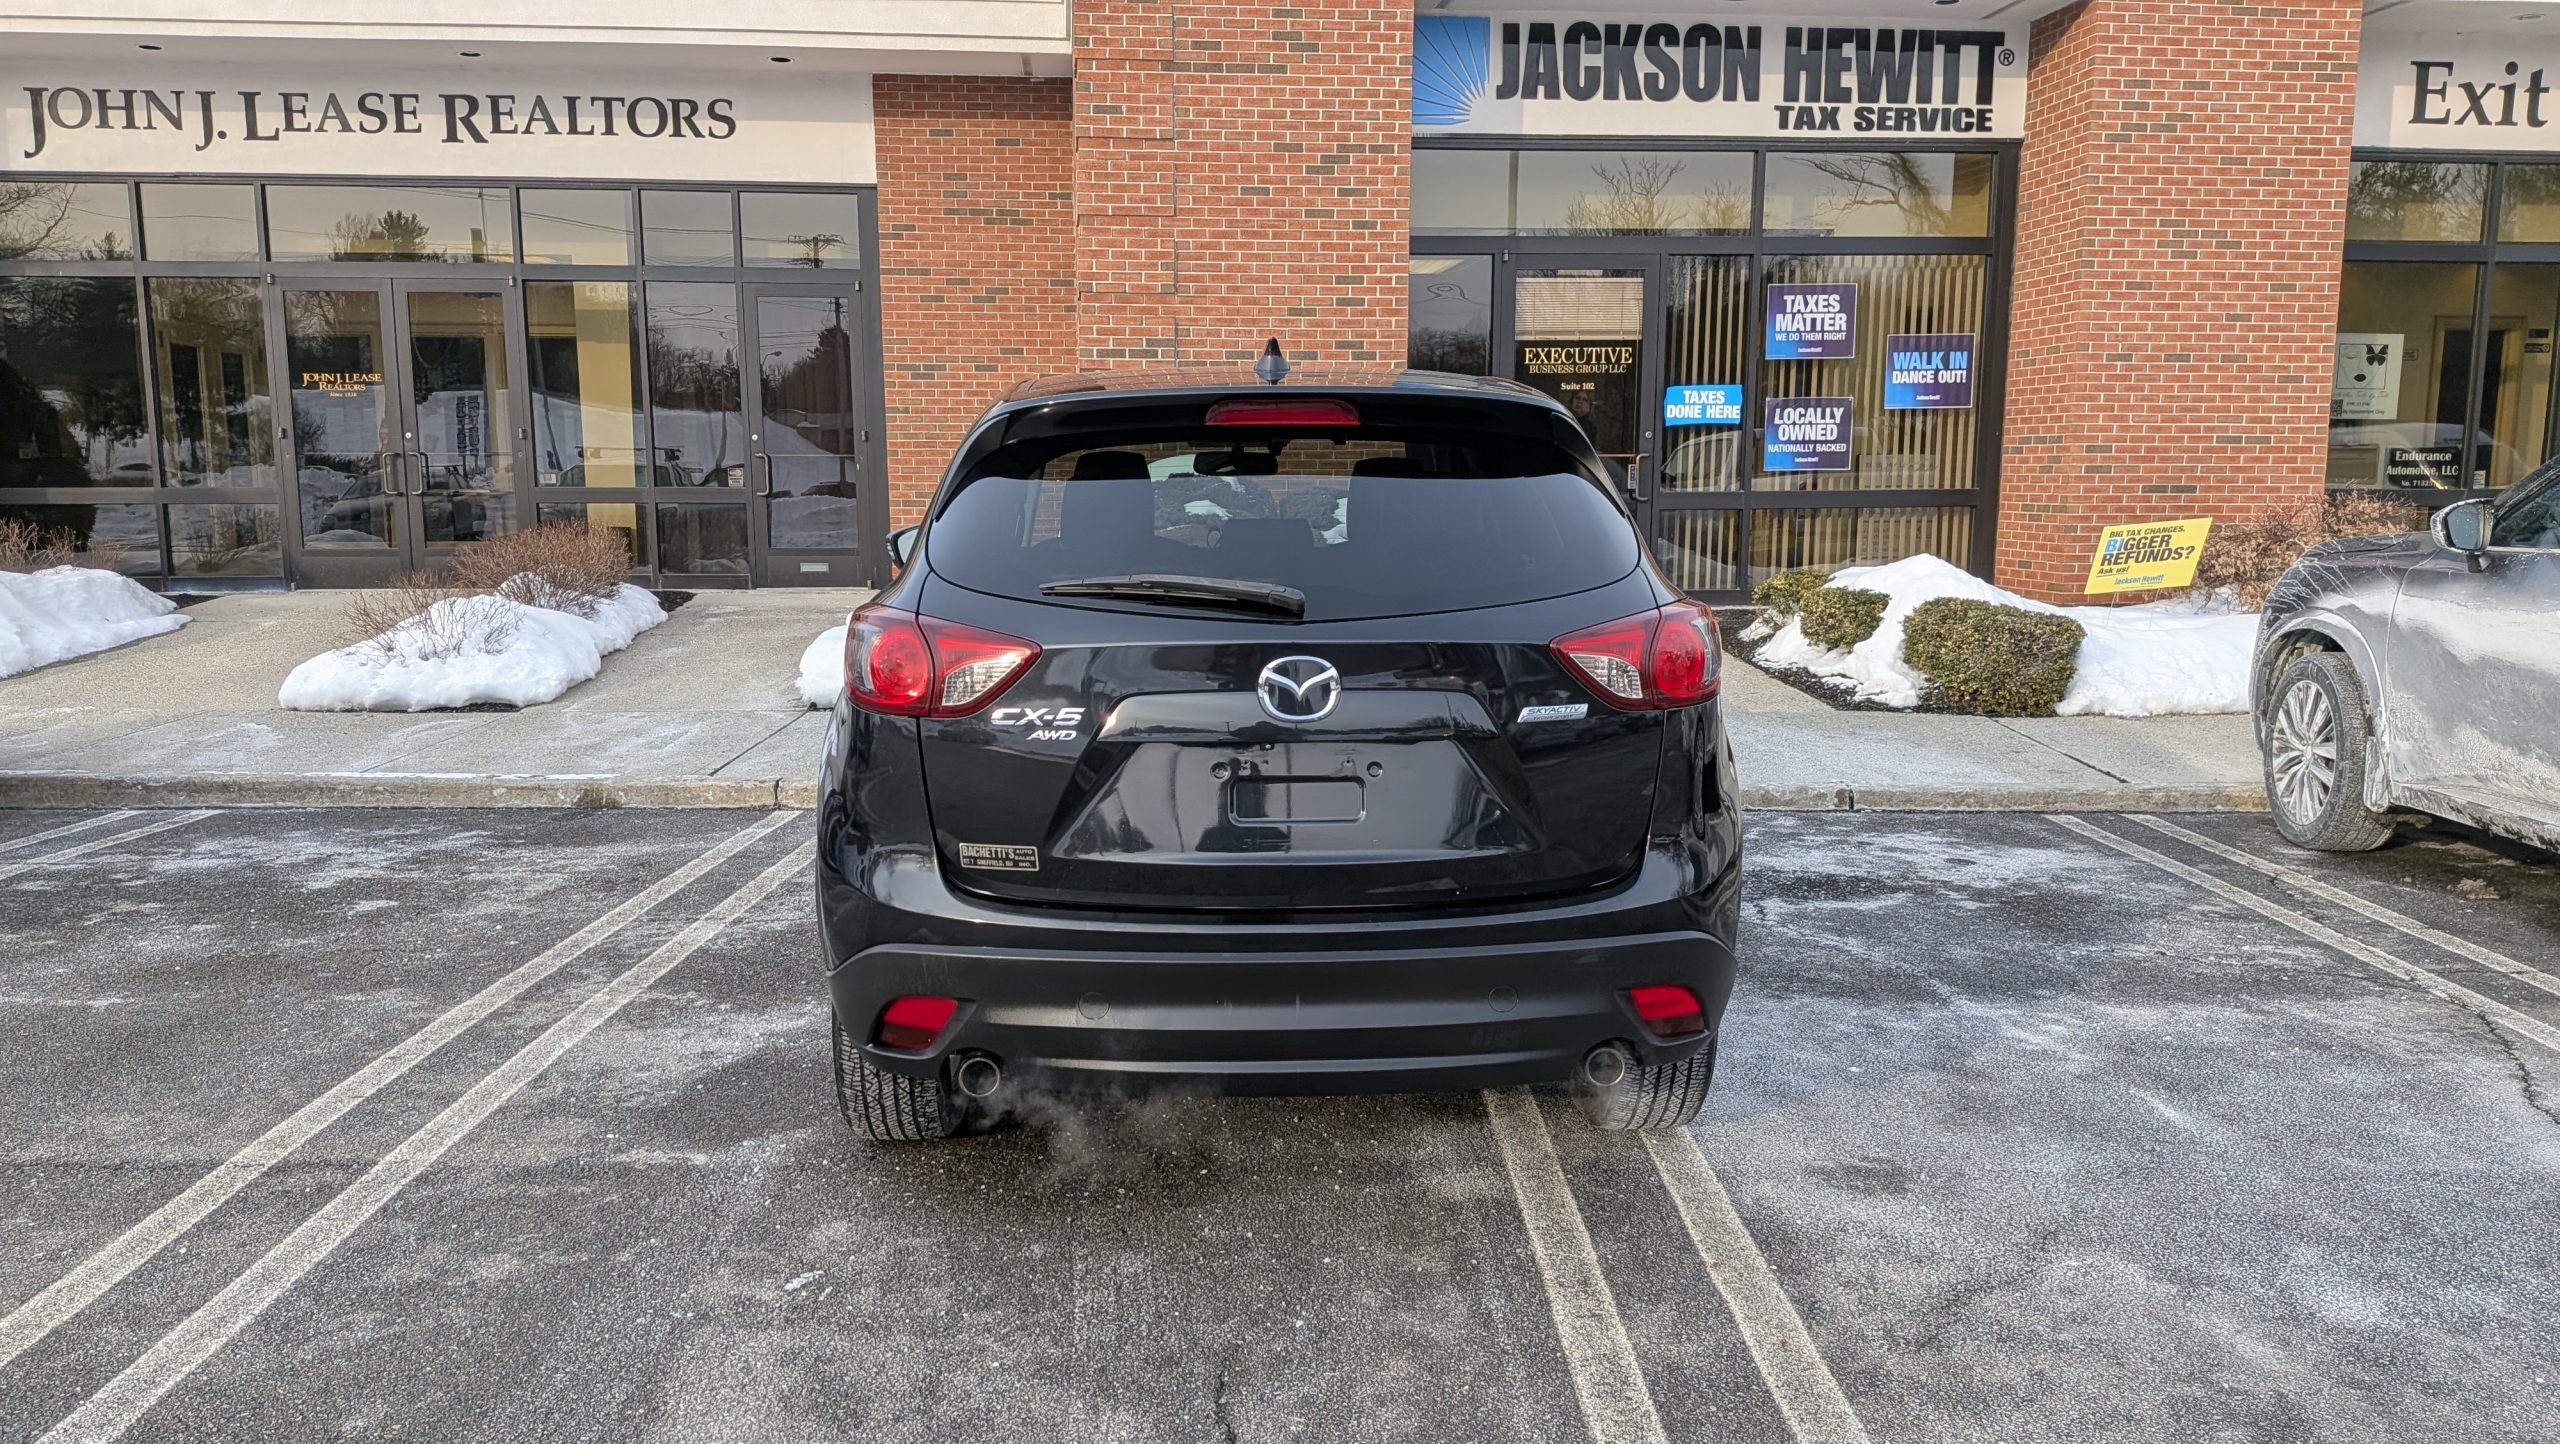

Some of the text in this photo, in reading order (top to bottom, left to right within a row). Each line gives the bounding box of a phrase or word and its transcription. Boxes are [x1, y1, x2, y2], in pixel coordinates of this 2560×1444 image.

[1496, 21, 1761, 102] JACKSON
[2408, 61, 2550, 128] Exit
[22, 86, 737, 159] JOHN J. LEASE REALTORS
[1774, 105, 1993, 132] TAX SERVICE
[1783, 294, 1841, 313] TAXES
[1775, 313, 1848, 332] MATTER
[1775, 332, 1847, 341] WE DO THEM RIGHT
[1524, 347, 1633, 364] EXECUTIVE
[1893, 351, 1968, 370] WALK IN
[1529, 364, 1627, 374] BUSINESS GROUP LLC
[302, 373, 334, 386] JOHN
[345, 373, 382, 383] LEASE
[1892, 370, 1967, 384] DANCE OUT!
[319, 382, 366, 391] REALTORS
[1561, 382, 1595, 390] Suite 102
[1683, 390, 1726, 404] TAXES
[1666, 404, 1741, 419] DONE HERE
[1774, 407, 1845, 424] LOCALLY
[1778, 424, 1838, 441] OWNED
[1768, 443, 1847, 453] NATIONALLY BACKED
[2395, 450, 2452, 461] Endurance
[2441, 465, 2459, 475] LLC
[2109, 525, 2186, 539] BIG TAX CHANGES.
[2104, 534, 2172, 553] BIGGER
[2100, 545, 2195, 567] REFUNDS?
[2098, 565, 2130, 575] Ask us!
[990, 707, 1087, 726] CX-5
[1527, 706, 1582, 714] SKYACTIV
[1025, 730, 1077, 741] AWD
